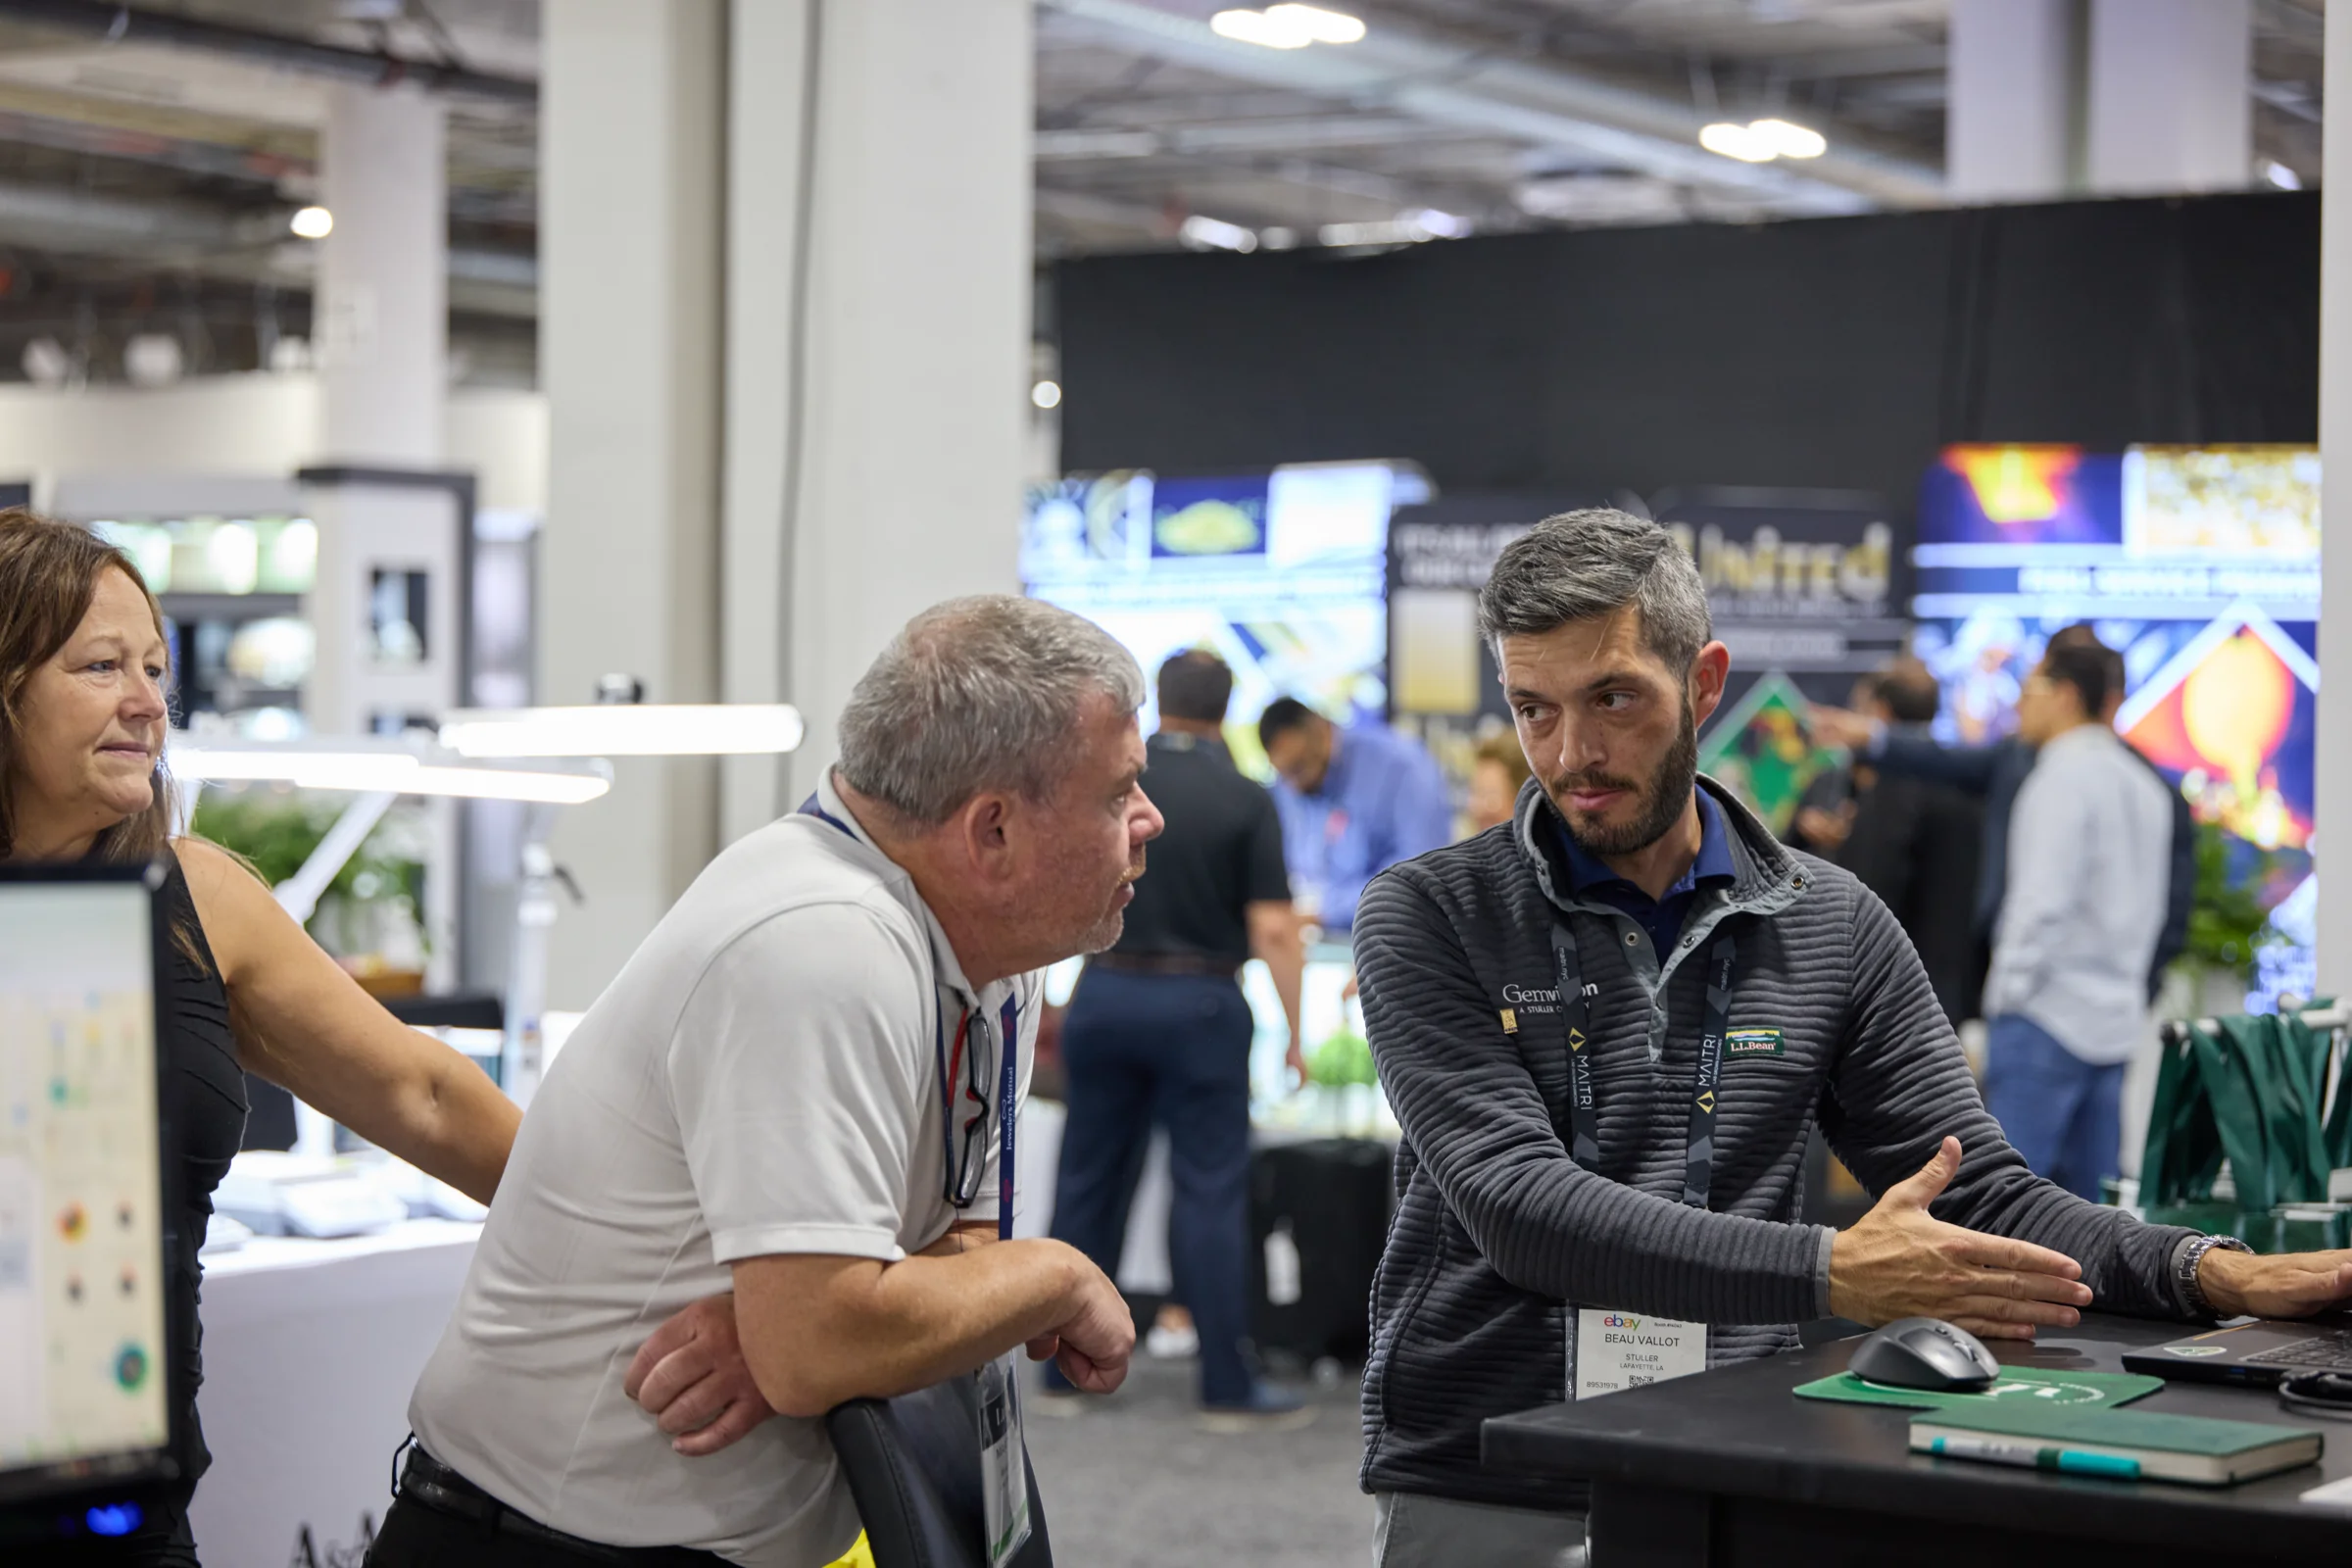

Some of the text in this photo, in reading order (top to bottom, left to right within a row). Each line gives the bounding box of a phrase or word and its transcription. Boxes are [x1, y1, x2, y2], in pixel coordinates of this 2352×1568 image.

[1698, 1034, 1717, 1087] MAITRI
[1577, 1054, 1592, 1110] MAITRI
[1604, 1314, 1641, 1331] ebay
[1605, 1334, 1680, 1347] BEAU VALLOT
[1626, 1353, 1658, 1362] STULLER
